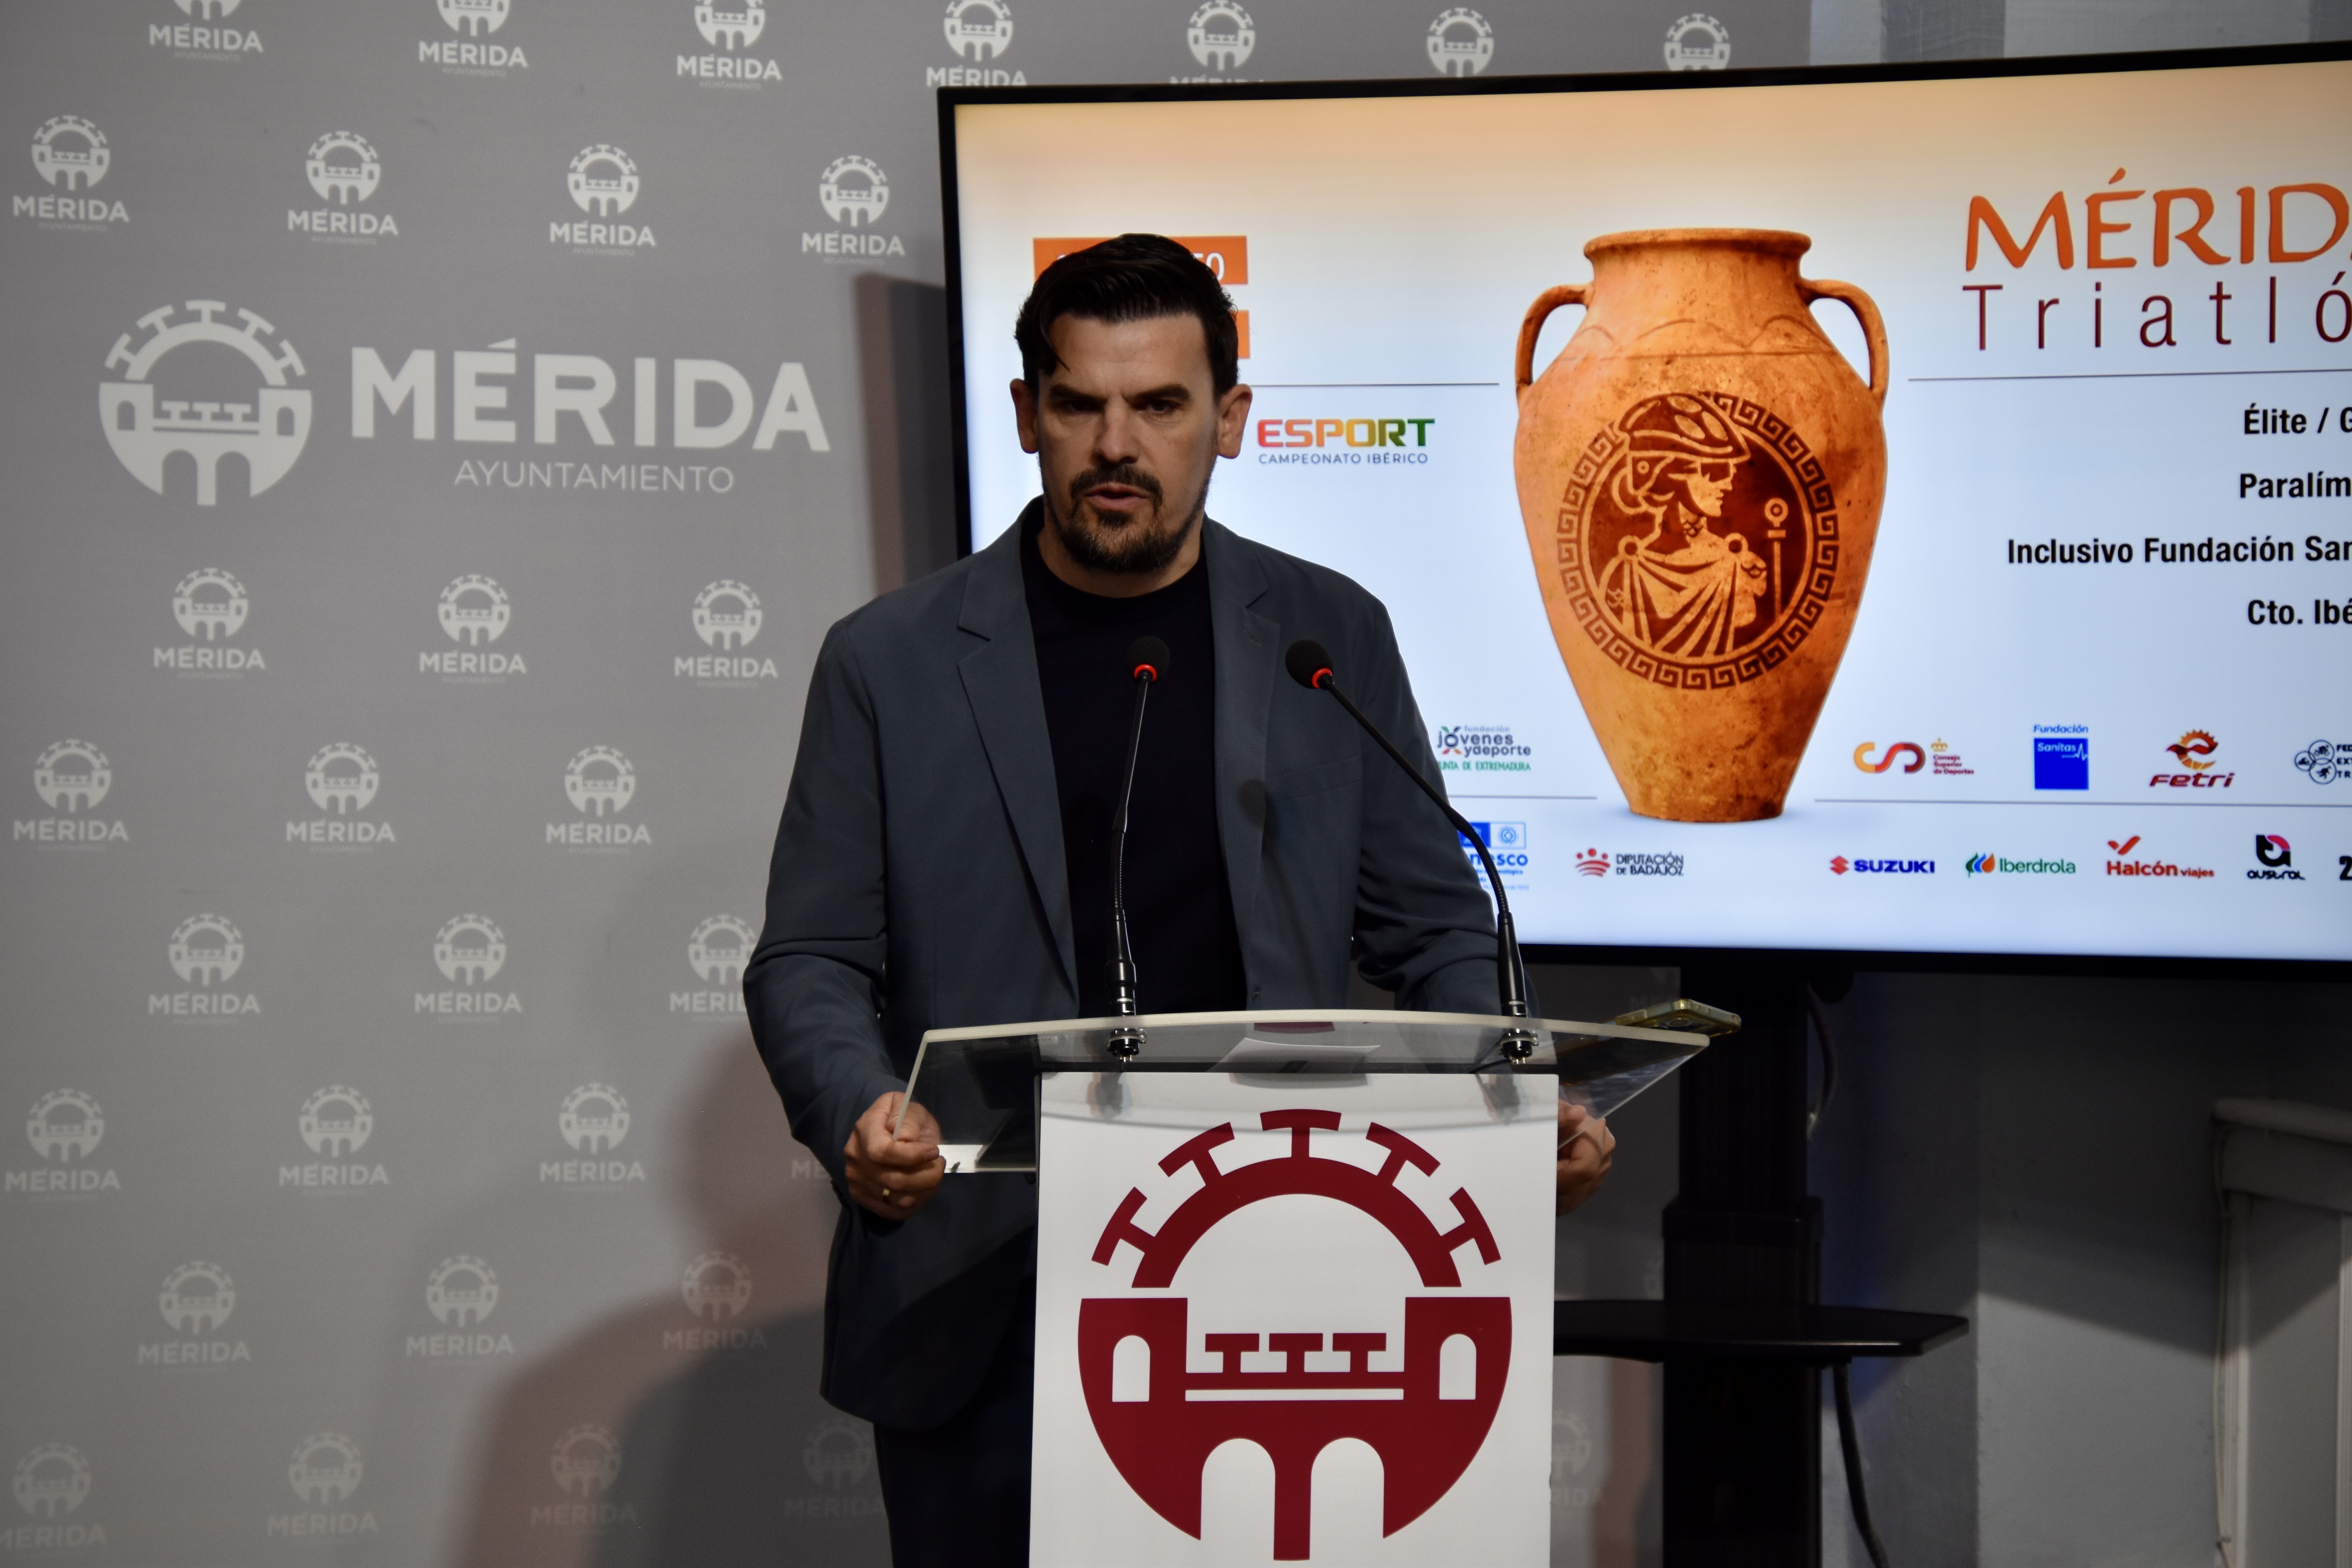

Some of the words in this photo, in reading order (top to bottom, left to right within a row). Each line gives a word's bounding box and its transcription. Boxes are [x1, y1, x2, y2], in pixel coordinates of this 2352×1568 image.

[149, 23, 263, 53] MÉRIDA
[418, 40, 528, 68] MÉRIDA
[677, 53, 782, 80] MÉRIDA
[13, 194, 130, 222] MÉRIDA
[1966, 167, 2352, 272] MÉRID
[287, 209, 398, 236] MÉRIDA
[549, 220, 656, 247] MÉRIDA
[802, 230, 905, 256] MÉRIDA
[351, 338, 831, 452] MÉRIDA
[2244, 403, 2307, 434] Élite
[1257, 418, 1436, 448] ESPORT
[1258, 453, 1361, 464] CAMPEONATO
[1367, 451, 1428, 464] IBÉRICO
[454, 459, 735, 493] AYUNTAMIENTO
[2239, 470, 2352, 498] Paralím
[2008, 539, 2133, 564] Inclusivo
[2144, 535, 2294, 563] Fundación
[2248, 600, 2303, 625] Cto.
[153, 644, 266, 669] MÉRIDA
[419, 649, 526, 674] MÉRIDA
[674, 653, 779, 678] MÉRIDA
[1437, 726, 1514, 748] jóvenes
[2033, 724, 2089, 733] Fundación
[1464, 745, 1532, 758] ydeporte
[2037, 742, 2076, 752] Sanitas
[1438, 760, 1459, 770] UNTA
[1463, 760, 1472, 770] DE
[1475, 760, 1531, 771] EXTREMADURA
[13, 817, 129, 841] MÉRIDA
[286, 818, 396, 842] MÉRIDA
[546, 821, 652, 844] MÉRIDA
[1616, 851, 1684, 865] DIPUTACIÓN
[1854, 860, 1935, 873] SUZUKI
[2000, 858, 2076, 873] Iberdrola
[2107, 861, 2179, 877] Halcón
[2181, 867, 2215, 879] viajes
[1630, 865, 1684, 876] BADAJOZ
[149, 991, 261, 1014] MÉRIDA
[414, 991, 522, 1013] MÉRIDA
[5, 1169, 121, 1192] MÉRIDA
[278, 1163, 389, 1187] MÉRIDA
[539, 1160, 646, 1182] MÉRIDA
